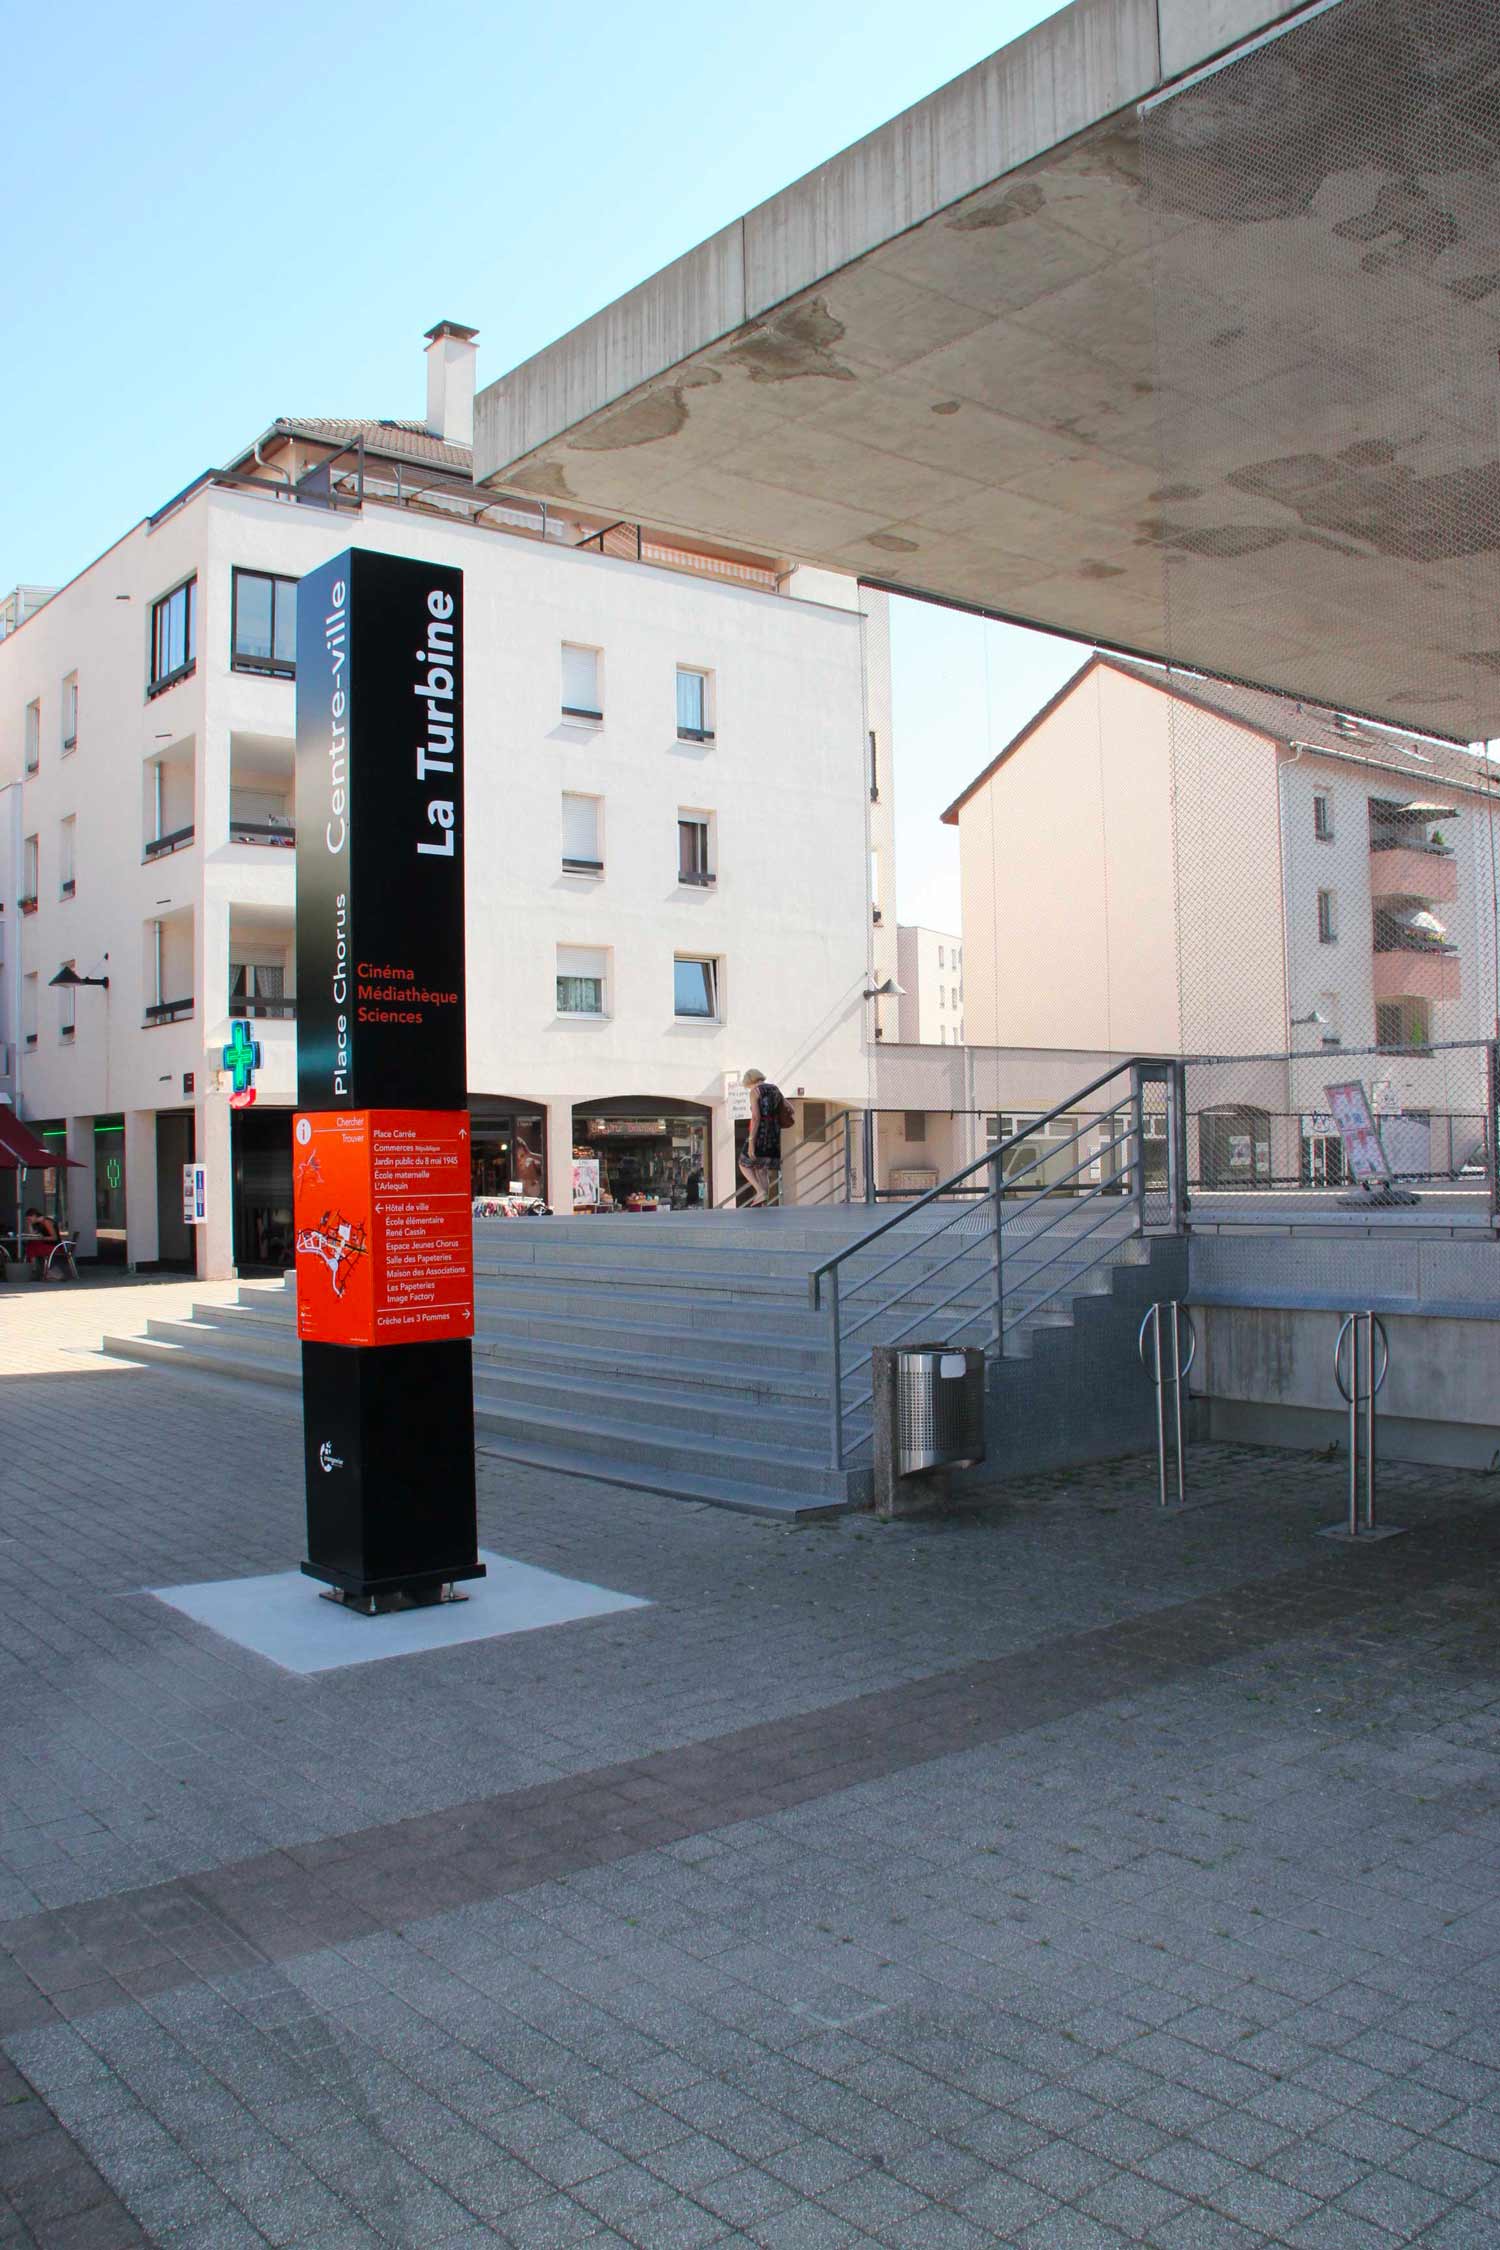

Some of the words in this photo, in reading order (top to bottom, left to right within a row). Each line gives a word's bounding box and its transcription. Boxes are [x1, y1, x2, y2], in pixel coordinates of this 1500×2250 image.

[414, 590, 455, 781] Turbine
[326, 580, 346, 855] Centre-ville
[416, 799, 455, 857] La
[333, 893, 346, 1004] Chorus
[357, 963, 415, 980] Cinéma
[358, 985, 459, 1006] Médiathèque
[358, 1007, 423, 1024] Sciences
[333, 1014, 348, 1095] Place
[336, 1117, 364, 1127] Chercher
[342, 1133, 364, 1143] Trouver
[373, 1129, 392, 1138] Place
[393, 1129, 417, 1138] Carrée
[373, 1143, 414, 1152] Commerces
[374, 1157, 394, 1166] Jardin
[395, 1157, 414, 1167] public
[415, 1157, 424, 1165] du
[425, 1157, 430, 1165] 8
[430, 1156, 442, 1165] mai
[443, 1156, 458, 1164] 1945
[374, 1169, 393, 1179] École
[394, 1170, 430, 1178] maternelle
[385, 1203, 404, 1212] Hôtel
[405, 1203, 414, 1211] de
[416, 1202, 429, 1211] ville
[385, 1216, 404, 1226] École
[405, 1216, 444, 1225] élémentaire
[385, 1228, 402, 1237] René
[404, 1228, 426, 1236] Cassin
[386, 1242, 410, 1252] Espace
[411, 1241, 435, 1249] Jeunes
[435, 1240, 459, 1248] Chorus
[386, 1255, 402, 1264] Salle
[404, 1255, 415, 1263] des
[417, 1254, 452, 1263] Papeteries
[386, 1269, 411, 1278] Maison
[412, 1268, 424, 1276] des
[425, 1266, 465, 1275] Associations
[386, 1284, 398, 1292] Les
[400, 1282, 435, 1292] Papeteries
[387, 1295, 409, 1304] Image
[409, 1293, 435, 1302] Factory
[377, 1316, 401, 1326] Crèche
[403, 1315, 415, 1323] Les
[416, 1314, 421, 1322] 3
[422, 1313, 450, 1322] Pommes
